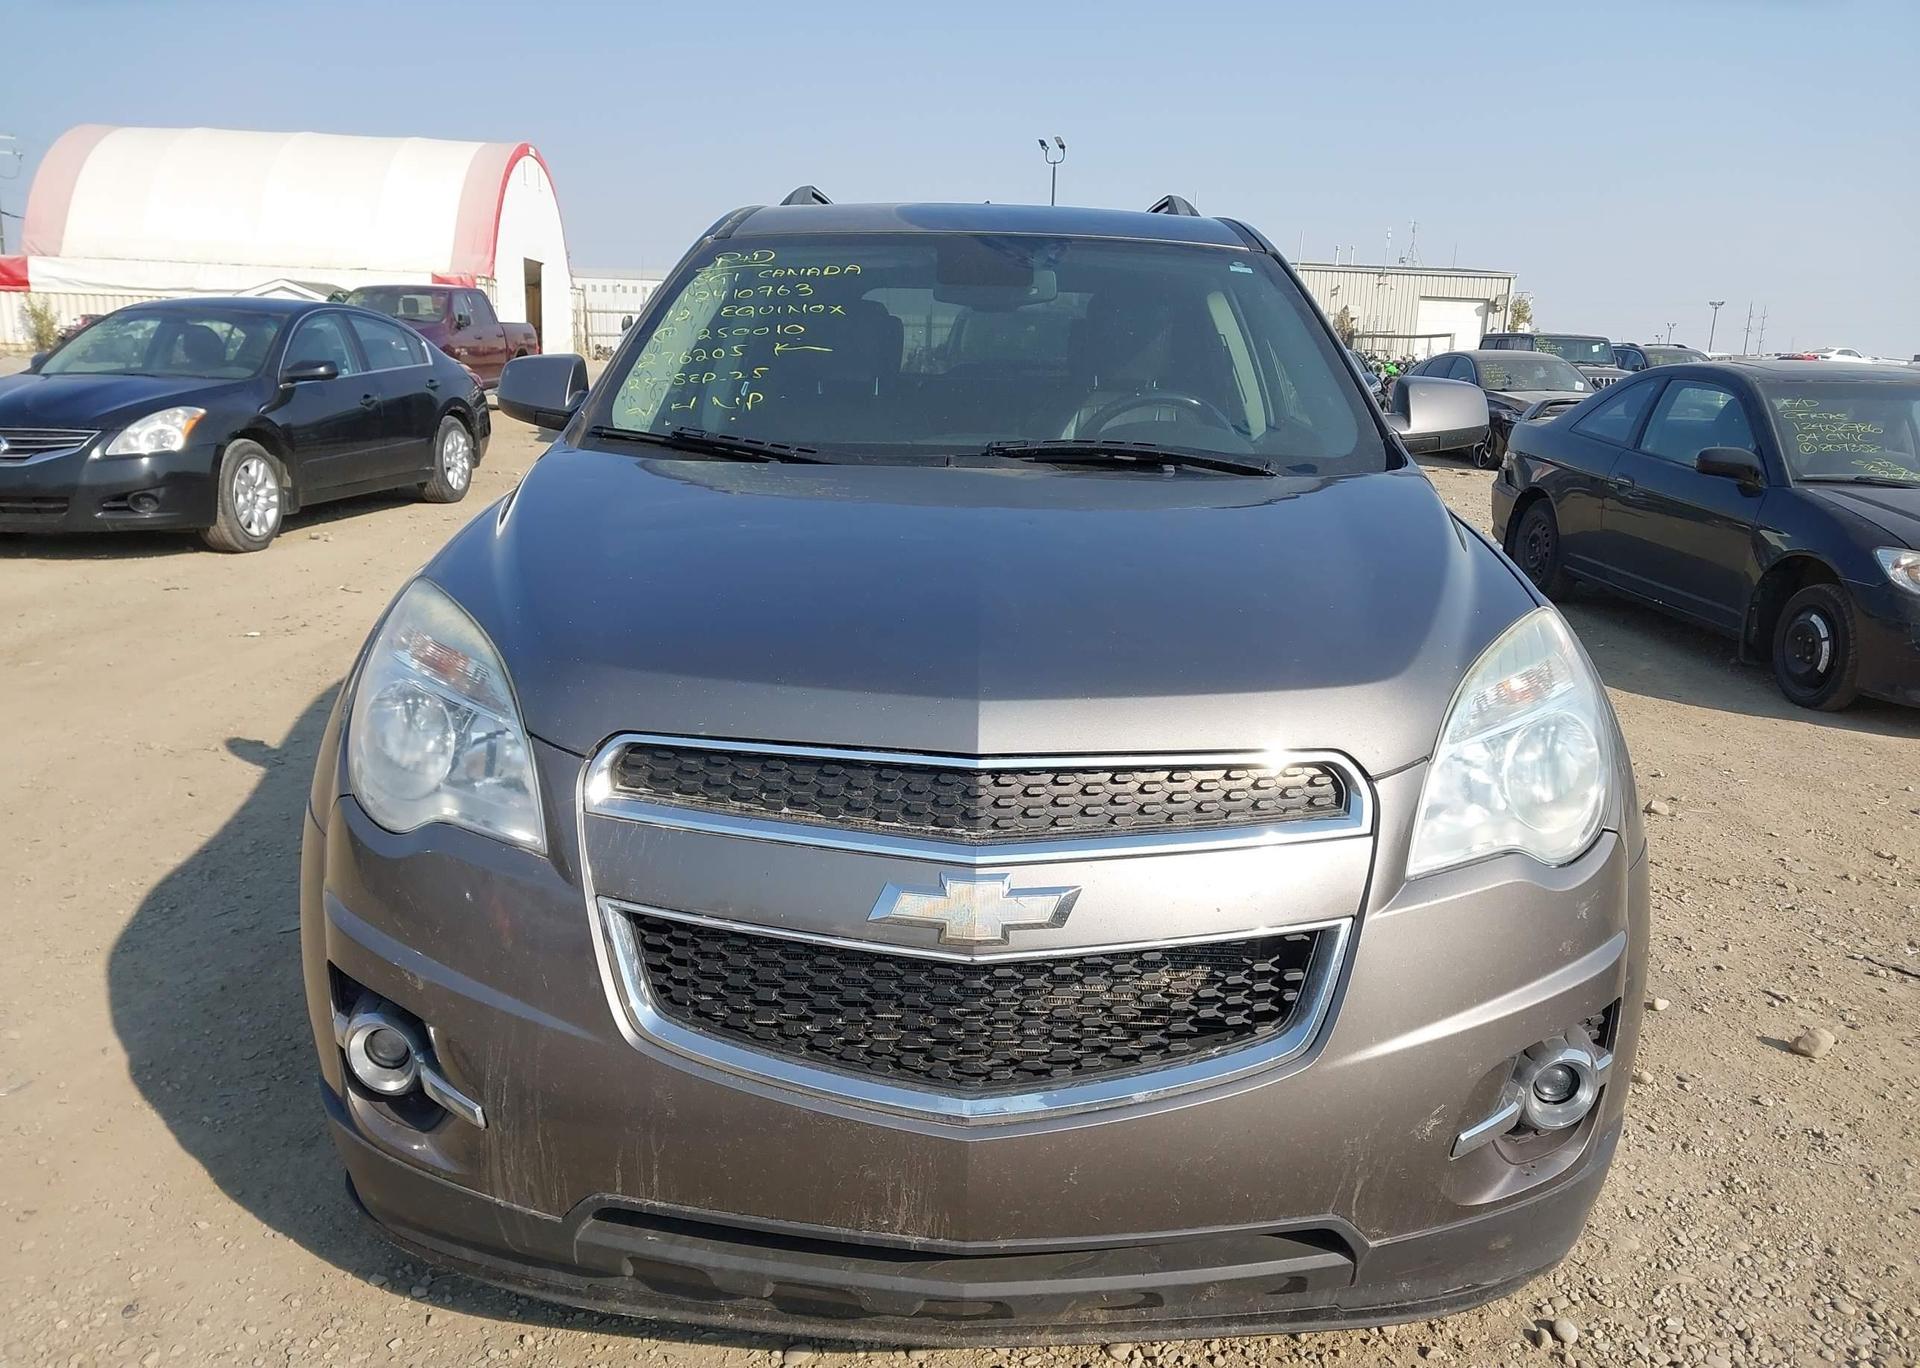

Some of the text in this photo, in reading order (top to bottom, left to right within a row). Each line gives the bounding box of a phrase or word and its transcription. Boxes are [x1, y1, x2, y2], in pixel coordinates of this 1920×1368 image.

[759, 264, 861, 279] CANADA
[721, 304, 846, 320] EQUINOX
[697, 324, 807, 341] 250010
[1826, 432, 1870, 443] CIVIC
